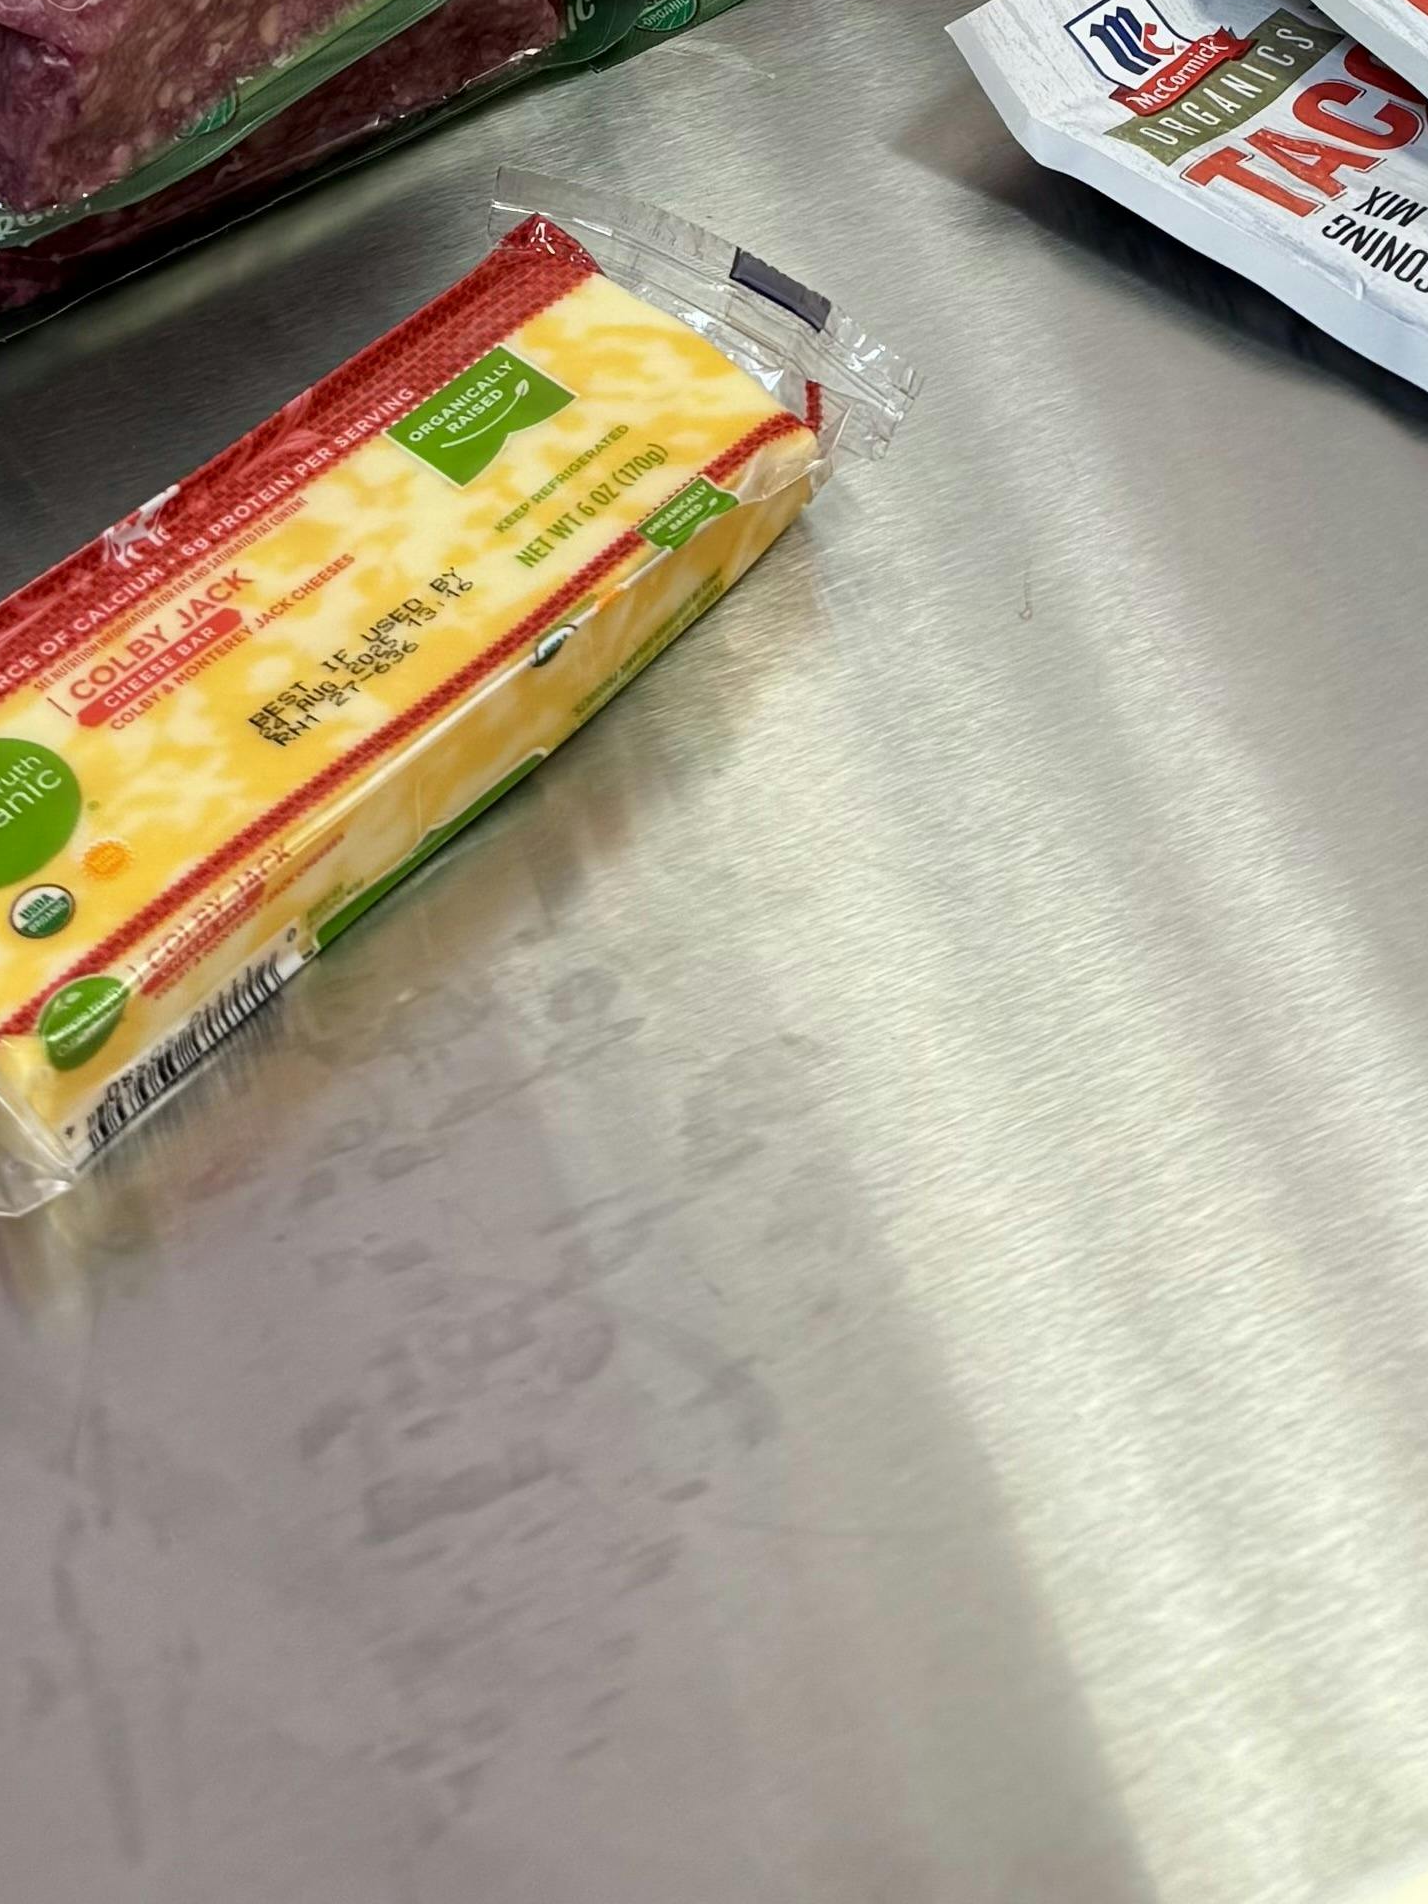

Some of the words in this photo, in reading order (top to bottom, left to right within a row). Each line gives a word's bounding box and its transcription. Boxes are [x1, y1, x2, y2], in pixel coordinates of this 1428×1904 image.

[1132, 36, 1225, 114] McCormick
[1137, 24, 1315, 148] ORGANICS
[409, 360, 514, 442] ORGANICALLY
[446, 389, 503, 434] RAISED
[69, 623, 168, 702] COLBY
[176, 569, 253, 630] JACK
[103, 659, 179, 711] CHEESE
[179, 626, 219, 662] BAR
